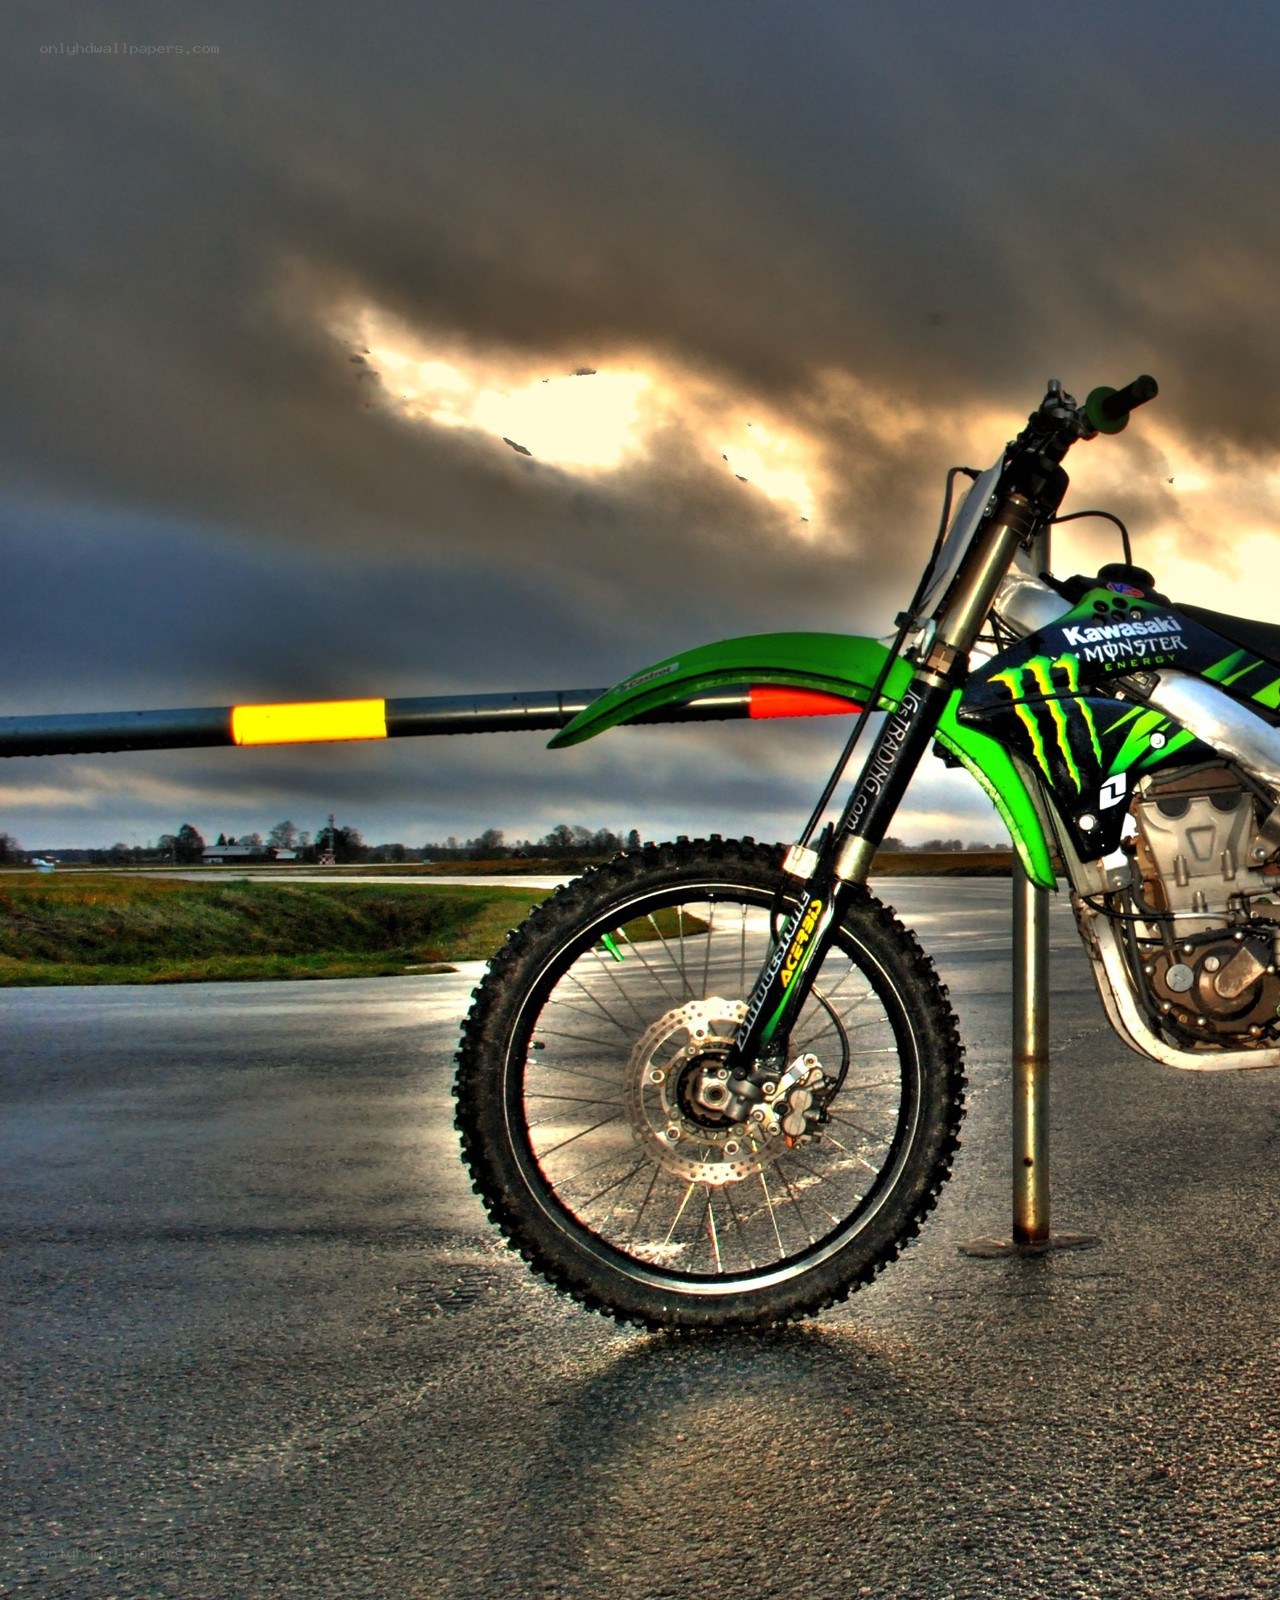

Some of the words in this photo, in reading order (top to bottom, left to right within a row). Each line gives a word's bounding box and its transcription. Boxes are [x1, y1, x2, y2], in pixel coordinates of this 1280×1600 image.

[1061, 616, 1182, 646] Kawasaki
[1083, 635, 1188, 663] MONSTER
[1104, 654, 1175, 671] ENERGY
